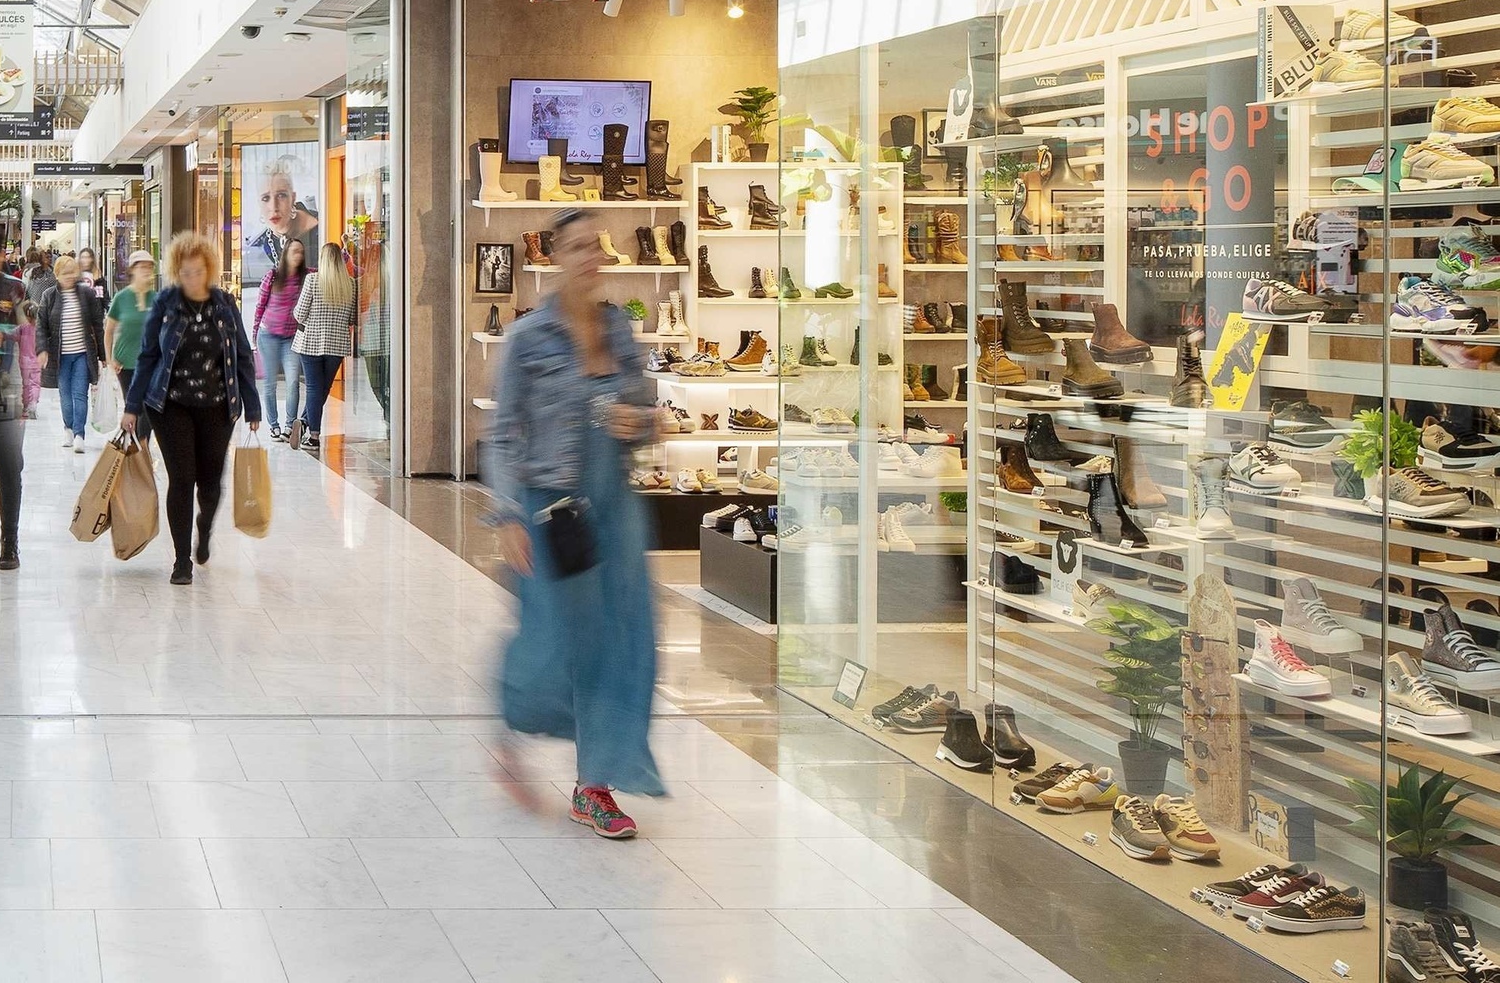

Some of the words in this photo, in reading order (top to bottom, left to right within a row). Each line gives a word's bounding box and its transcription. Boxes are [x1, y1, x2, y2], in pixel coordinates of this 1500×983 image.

[1034, 76, 1057, 86] VANS
[1146, 104, 1268, 157] SHOP
[1188, 165, 1252, 212] GO
[1144, 270, 1153, 278] TE
[1155, 270, 1165, 278] LO
[1167, 270, 1204, 279] LLEVAMOS
[1207, 271, 1233, 279] DONDE
[1236, 271, 1270, 279] QUIERAS
[101, 458, 121, 499] #bershkastyle
